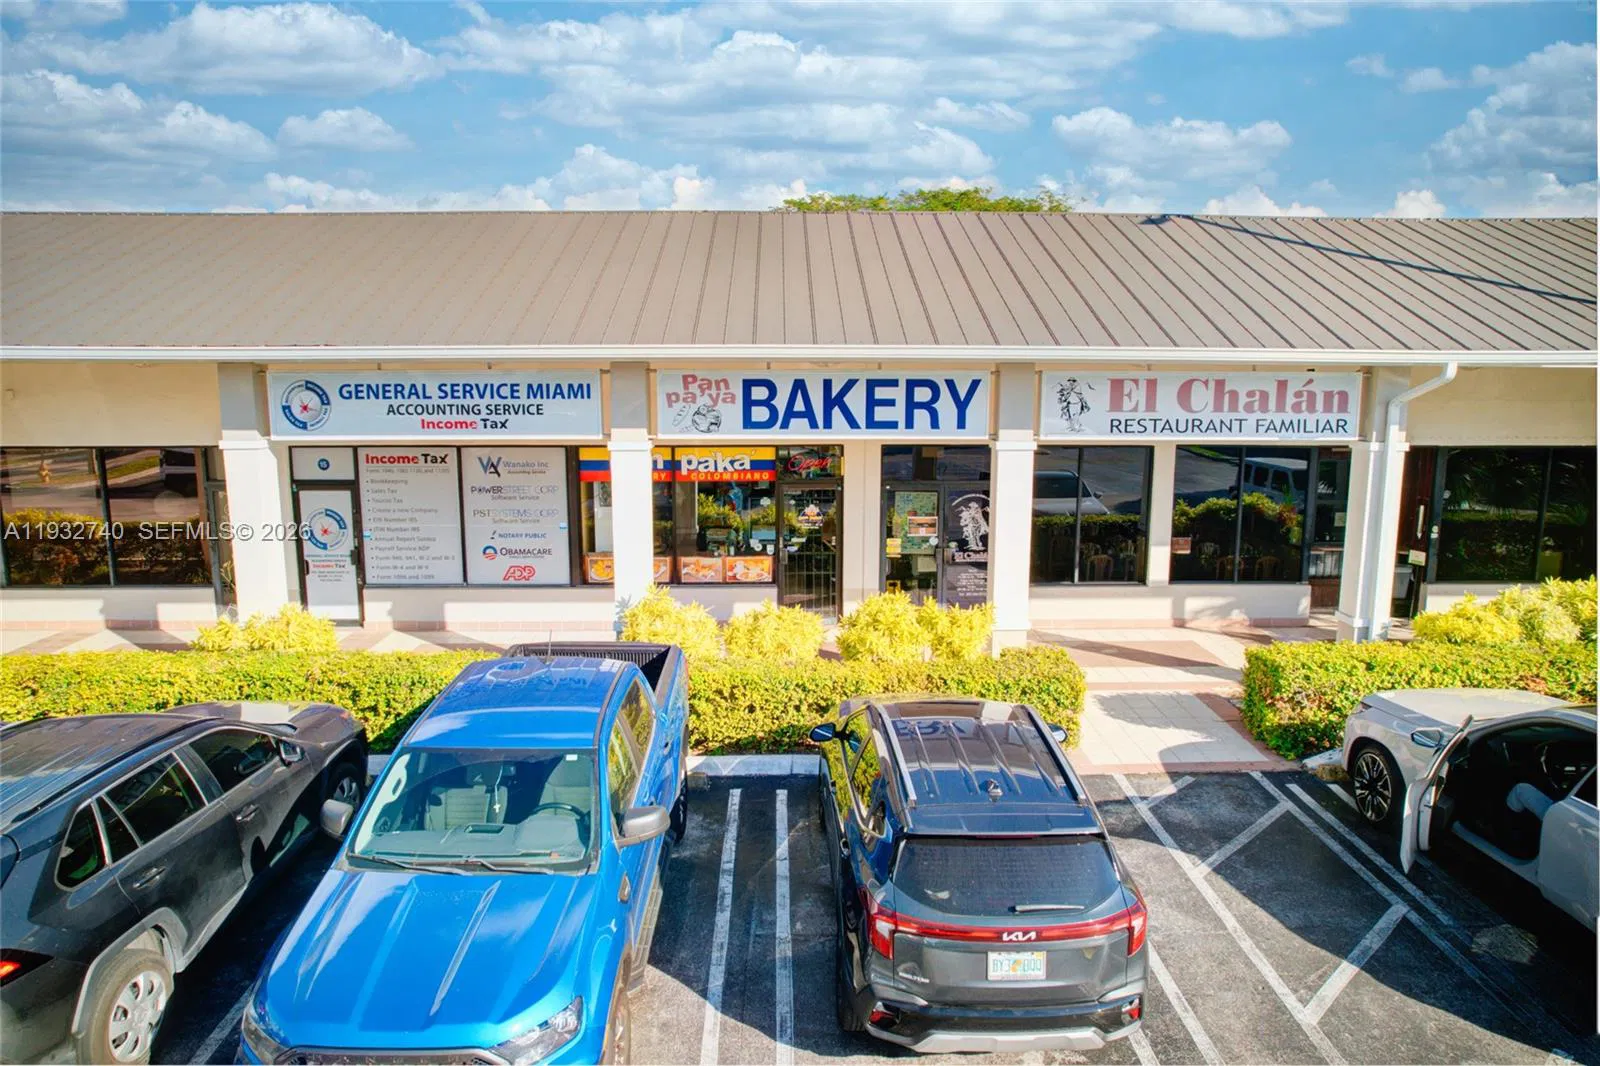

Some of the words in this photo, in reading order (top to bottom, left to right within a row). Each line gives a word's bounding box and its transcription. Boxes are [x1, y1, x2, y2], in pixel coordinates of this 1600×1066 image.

[681, 373, 730, 391] Pan
[338, 383, 432, 400] GENERAL
[438, 383, 522, 400] SERVICE
[526, 383, 591, 400] MIAMI
[1106, 377, 1159, 414] El
[1176, 377, 1350, 414] Chalán
[387, 403, 482, 416] ACCOUNTING
[486, 403, 544, 416] SERVICE
[741, 377, 982, 430] BAKERY
[421, 418, 477, 430] Income
[480, 418, 509, 430] Tax
[1110, 418, 1248, 433] RESTAURANT
[1255, 418, 1349, 433] FAMILIAR
[365, 453, 419, 464] Income
[421, 453, 448, 464] Tax
[787, 454, 832, 472] Open
[691, 472, 769, 480] COLOMBIANO
[535, 485, 559, 494] CORP
[534, 508, 559, 517] CORP
[502, 565, 536, 581] ADP
